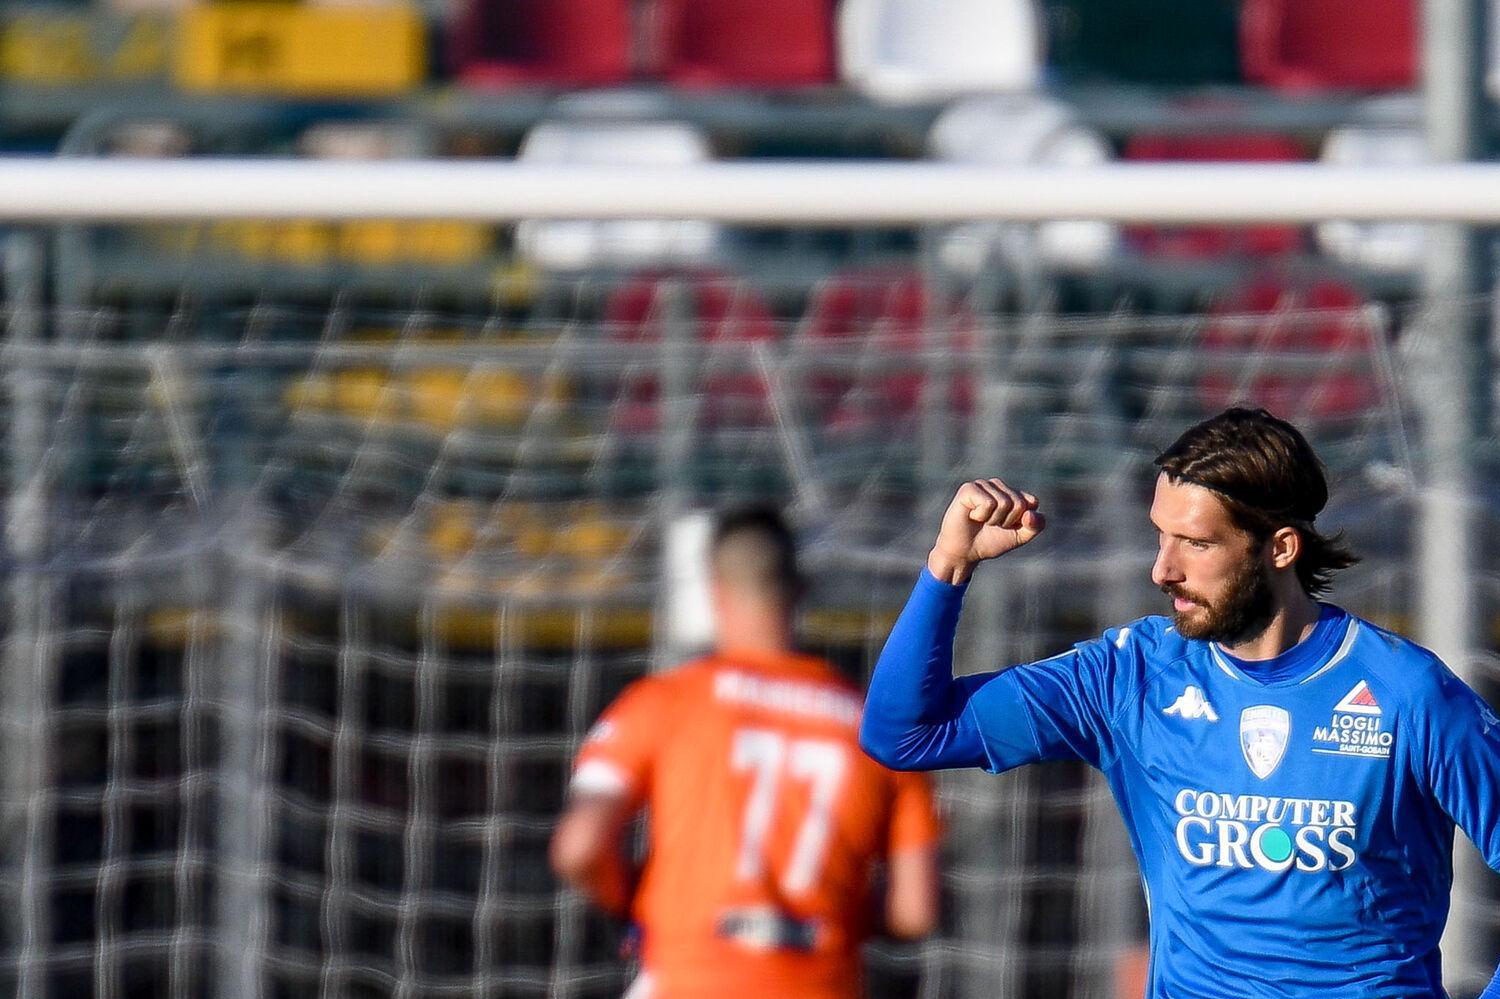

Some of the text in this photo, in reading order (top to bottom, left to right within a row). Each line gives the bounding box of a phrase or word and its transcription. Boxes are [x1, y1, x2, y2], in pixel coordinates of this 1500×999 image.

[1312, 726, 1393, 747] MASSIMO
[1331, 713, 1381, 732] LOGLI
[730, 728, 847, 898] 77
[1174, 788, 1357, 827] COMPUTER
[1175, 815, 1357, 873] GROSS
